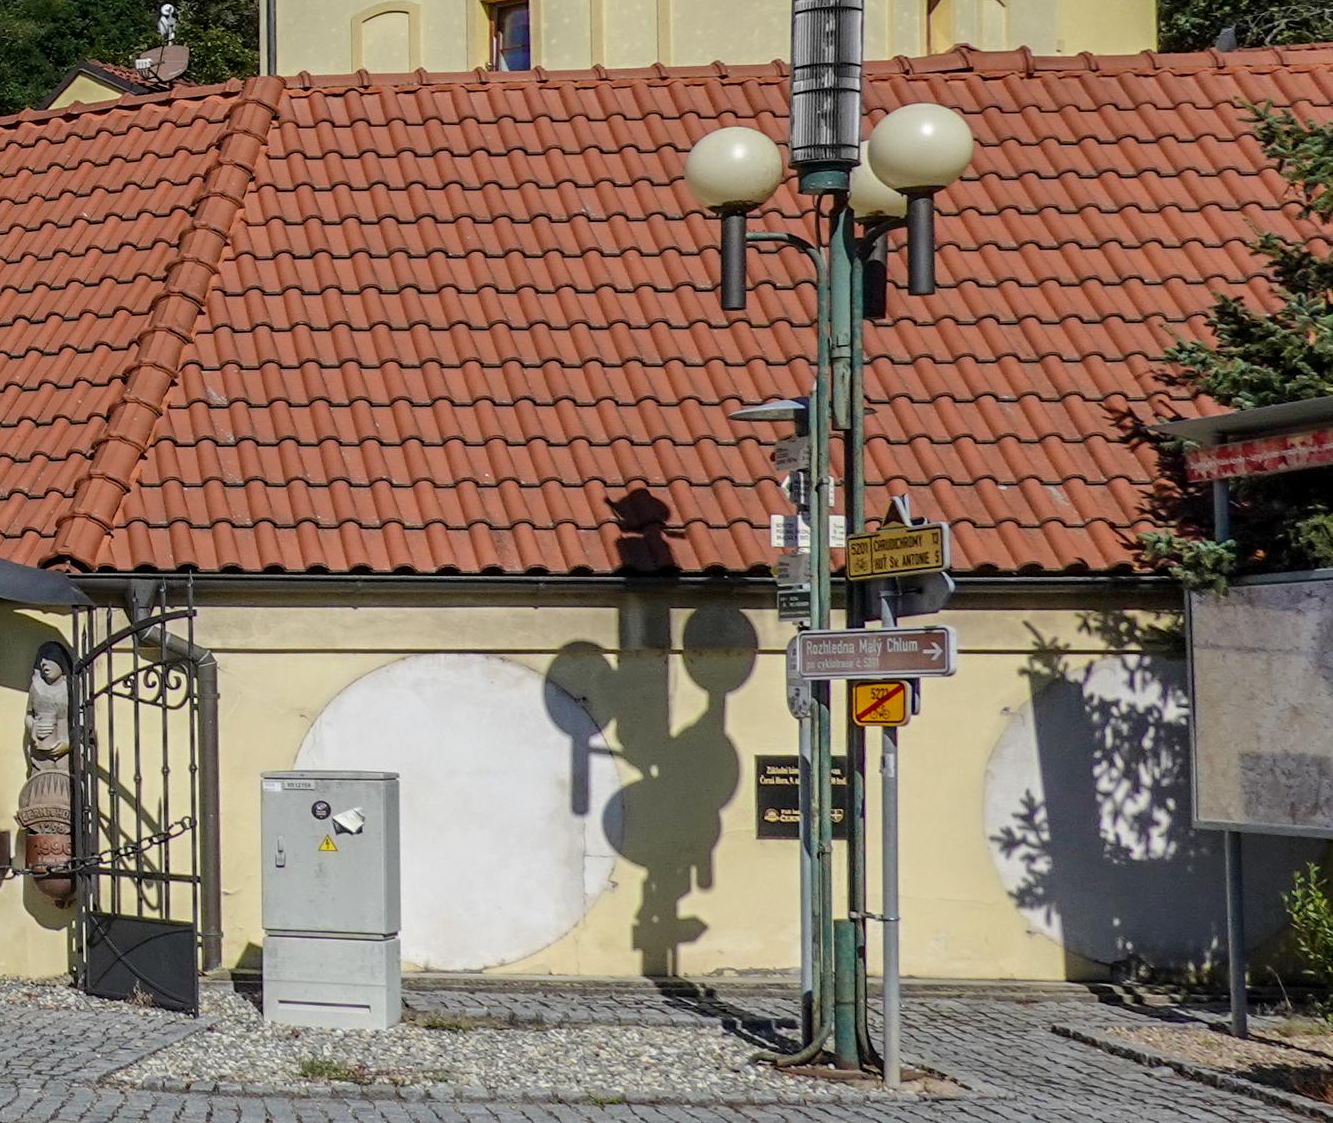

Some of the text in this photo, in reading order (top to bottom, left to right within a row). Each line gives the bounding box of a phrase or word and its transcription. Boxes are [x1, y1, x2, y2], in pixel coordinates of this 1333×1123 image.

[902, 551, 931, 566] ANTONIE
[806, 637, 918, 657] Rozhledna Malý Chlum
